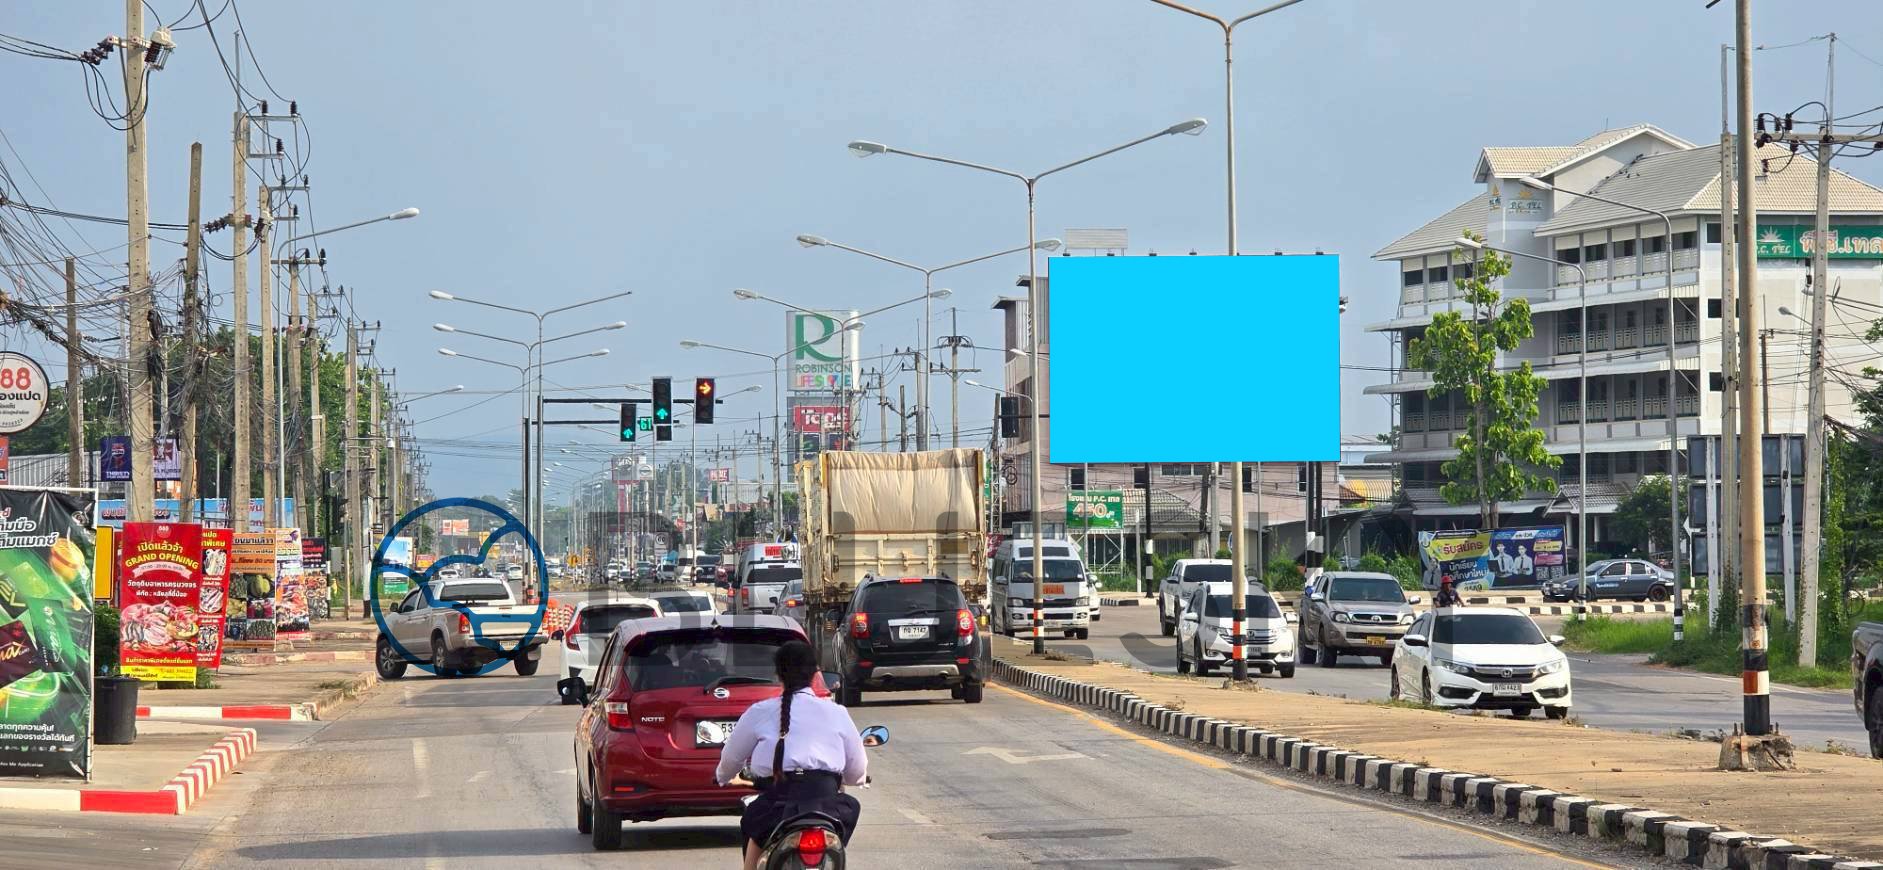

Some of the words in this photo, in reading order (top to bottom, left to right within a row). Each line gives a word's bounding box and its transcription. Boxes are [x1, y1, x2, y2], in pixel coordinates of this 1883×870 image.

[795, 363, 852, 373] ROBINSON
[640, 417, 652, 431] 61
[1443, 540, 1484, 555] รับสมัคร
[125, 553, 157, 567] GRAND
[158, 552, 200, 570] OPENING
[1443, 569, 1488, 581] ักศึกษาใหม่
